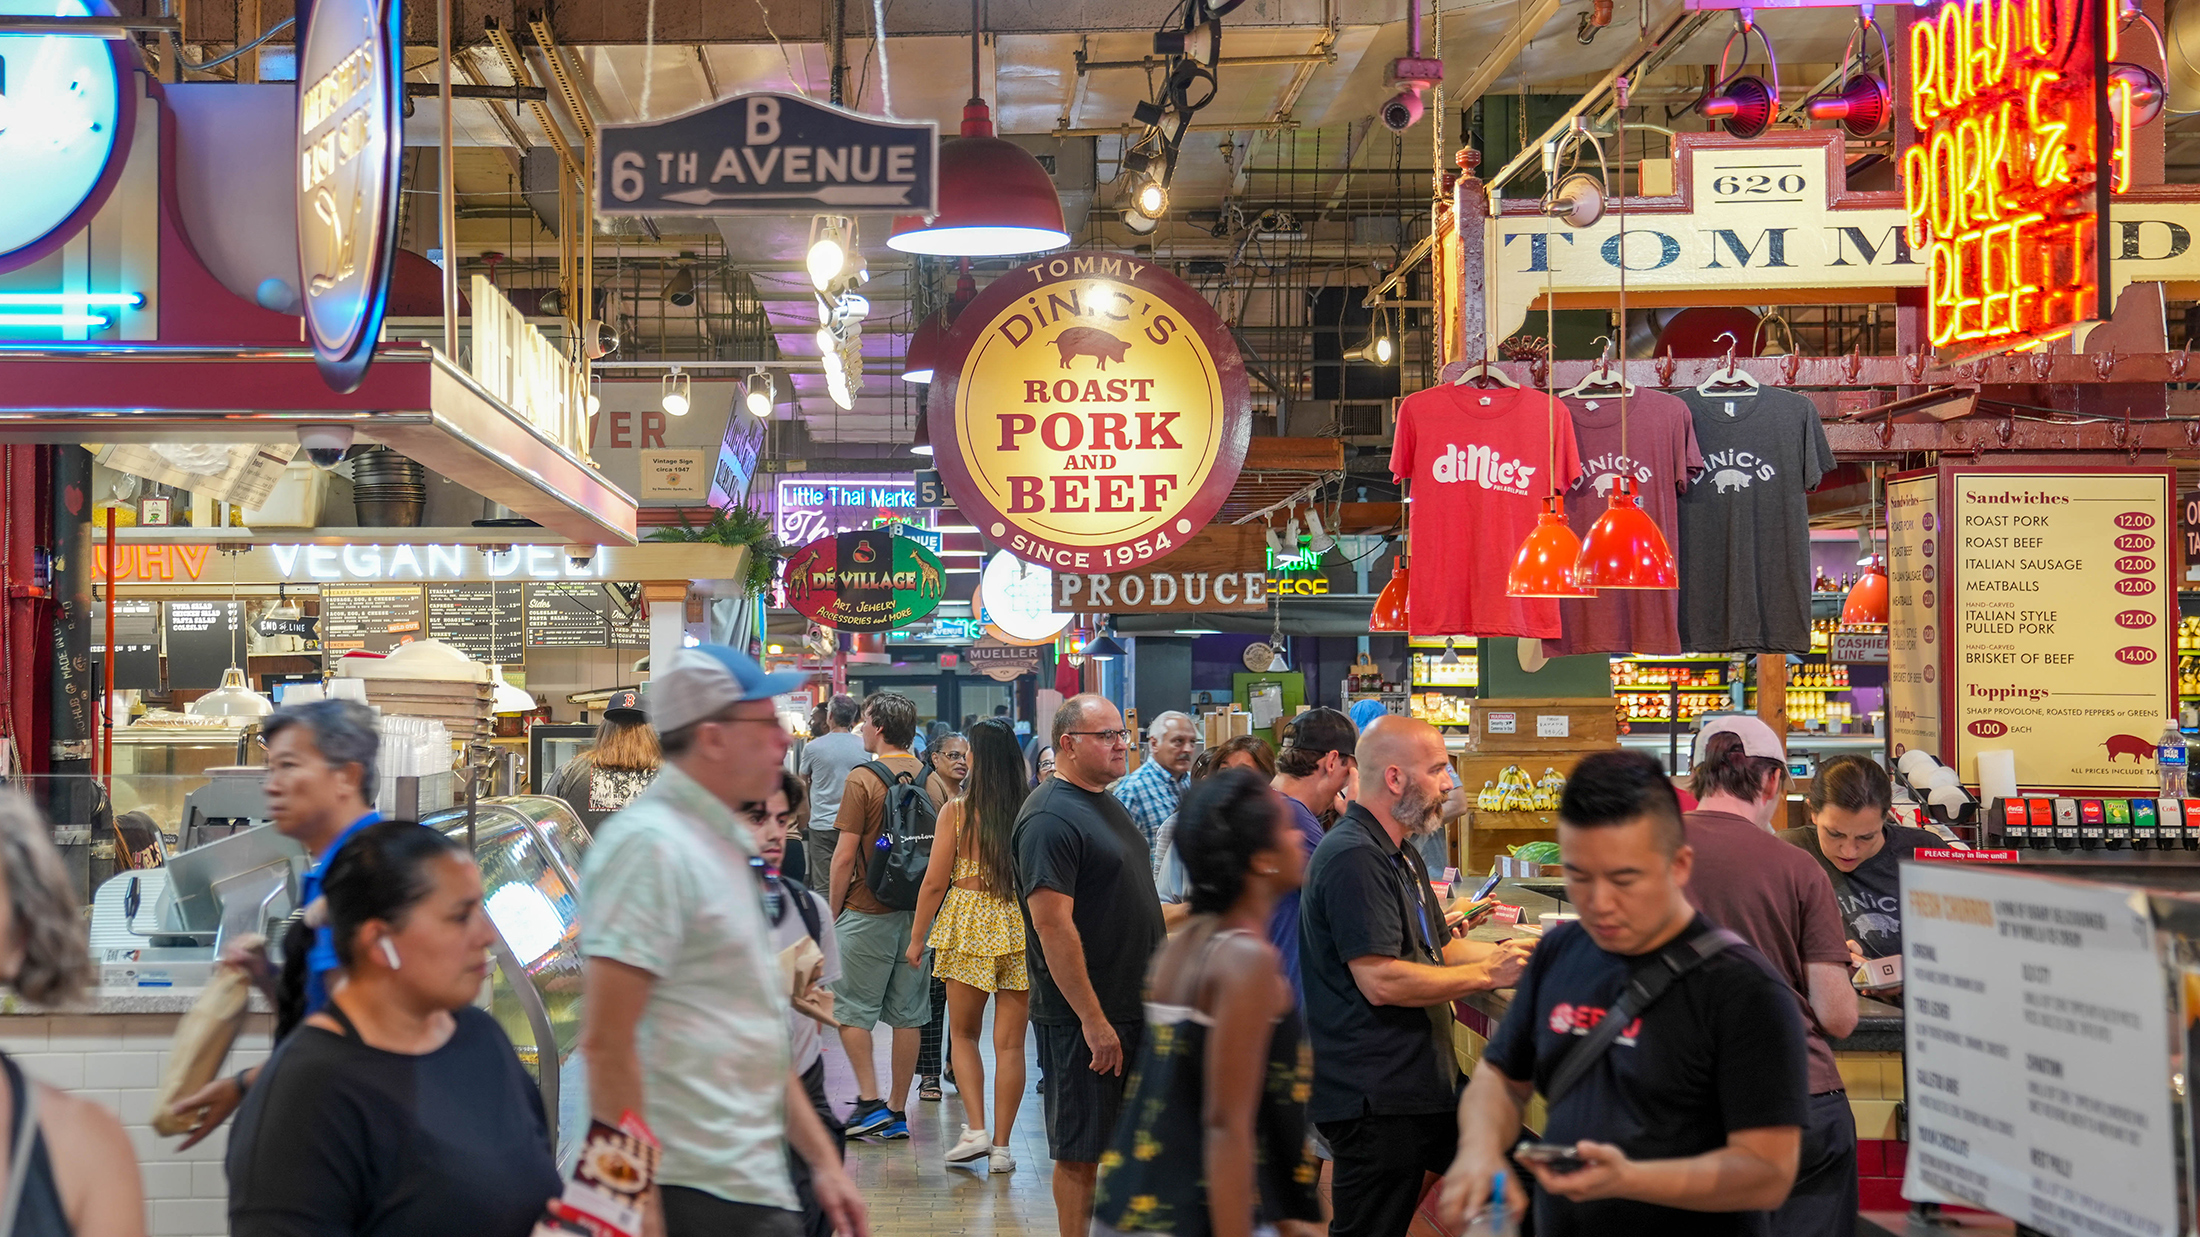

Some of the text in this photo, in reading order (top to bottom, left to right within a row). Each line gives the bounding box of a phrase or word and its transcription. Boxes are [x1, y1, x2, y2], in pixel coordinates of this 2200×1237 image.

[746, 97, 781, 145] B
[611, 146, 917, 202] 6 TH AVENUE
[1904, 102, 2020, 250] PORK
[1712, 174, 1806, 196] 620
[1503, 226, 1927, 273] TOMM
[1027, 256, 1146, 283] TOMMY
[1928, 213, 2046, 347] BEEF
[1023, 378, 1155, 403] ROAST
[996, 411, 1183, 452] PORK
[1063, 454, 1117, 470] AND
[783, 486, 825, 507] Little
[828, 486, 866, 507] Thai
[870, 487, 916, 508] Marke
[922, 481, 937, 503] 5
[1006, 474, 1178, 514] BEEF
[1493, 484, 1529, 496] PHILADELPHIA
[1965, 490, 2070, 505] Sandwiches
[1891, 495, 1919, 509] Sandwiches
[1965, 515, 2152, 528] ROAST PORK 12.00
[1011, 531, 1173, 569] SINCE 1954
[1965, 537, 2153, 549] ROAST BEEF 12.00
[91, 545, 210, 579] UHV
[272, 543, 462, 577] VEGAN
[1965, 559, 2153, 571] ITALIAN SAUSAGE 12.00
[812, 566, 917, 591] DÉ VILLAGE
[1059, 572, 1266, 606] PRODUCE
[1965, 580, 2153, 593] MEATBALLS 12.00
[528, 598, 551, 608] Sides
[872, 617, 888, 625] and
[888, 607, 913, 622] MORE
[1965, 611, 2154, 626] ITALIAN STYLE 12.00
[260, 620, 306, 632] END LINE
[932, 627, 963, 635] AVENUE
[936, 620, 944, 629] B
[1965, 623, 2055, 635] PULLED PORK
[941, 654, 958, 667] EXIT
[970, 648, 1038, 659] MUELLER
[1837, 649, 1866, 660] LINE
[1965, 650, 2154, 665] BRISKET OF BEEF 14.00
[58, 650, 73, 680] MADE
[979, 660, 1019, 668] CHOCOLATE
[1966, 683, 2049, 702] Toppings
[622, 693, 636, 708] B
[1894, 706, 1916, 724] Toppings
[1966, 708, 1993, 716] SHARP
[1994, 708, 2045, 717] PROVOLONE,
[2046, 708, 2083, 717] ROASTED
[2085, 709, 2115, 717] PEPPERS
[2127, 709, 2159, 718] GREENS
[1974, 723, 2032, 735] 1.00 EACH
[2070, 767, 2083, 775] ALL
[2161, 805, 2178, 813] Coke
[1924, 850, 1950, 858] PLEASE
[1951, 850, 1965, 860] stay
[1976, 851, 1989, 859] line
